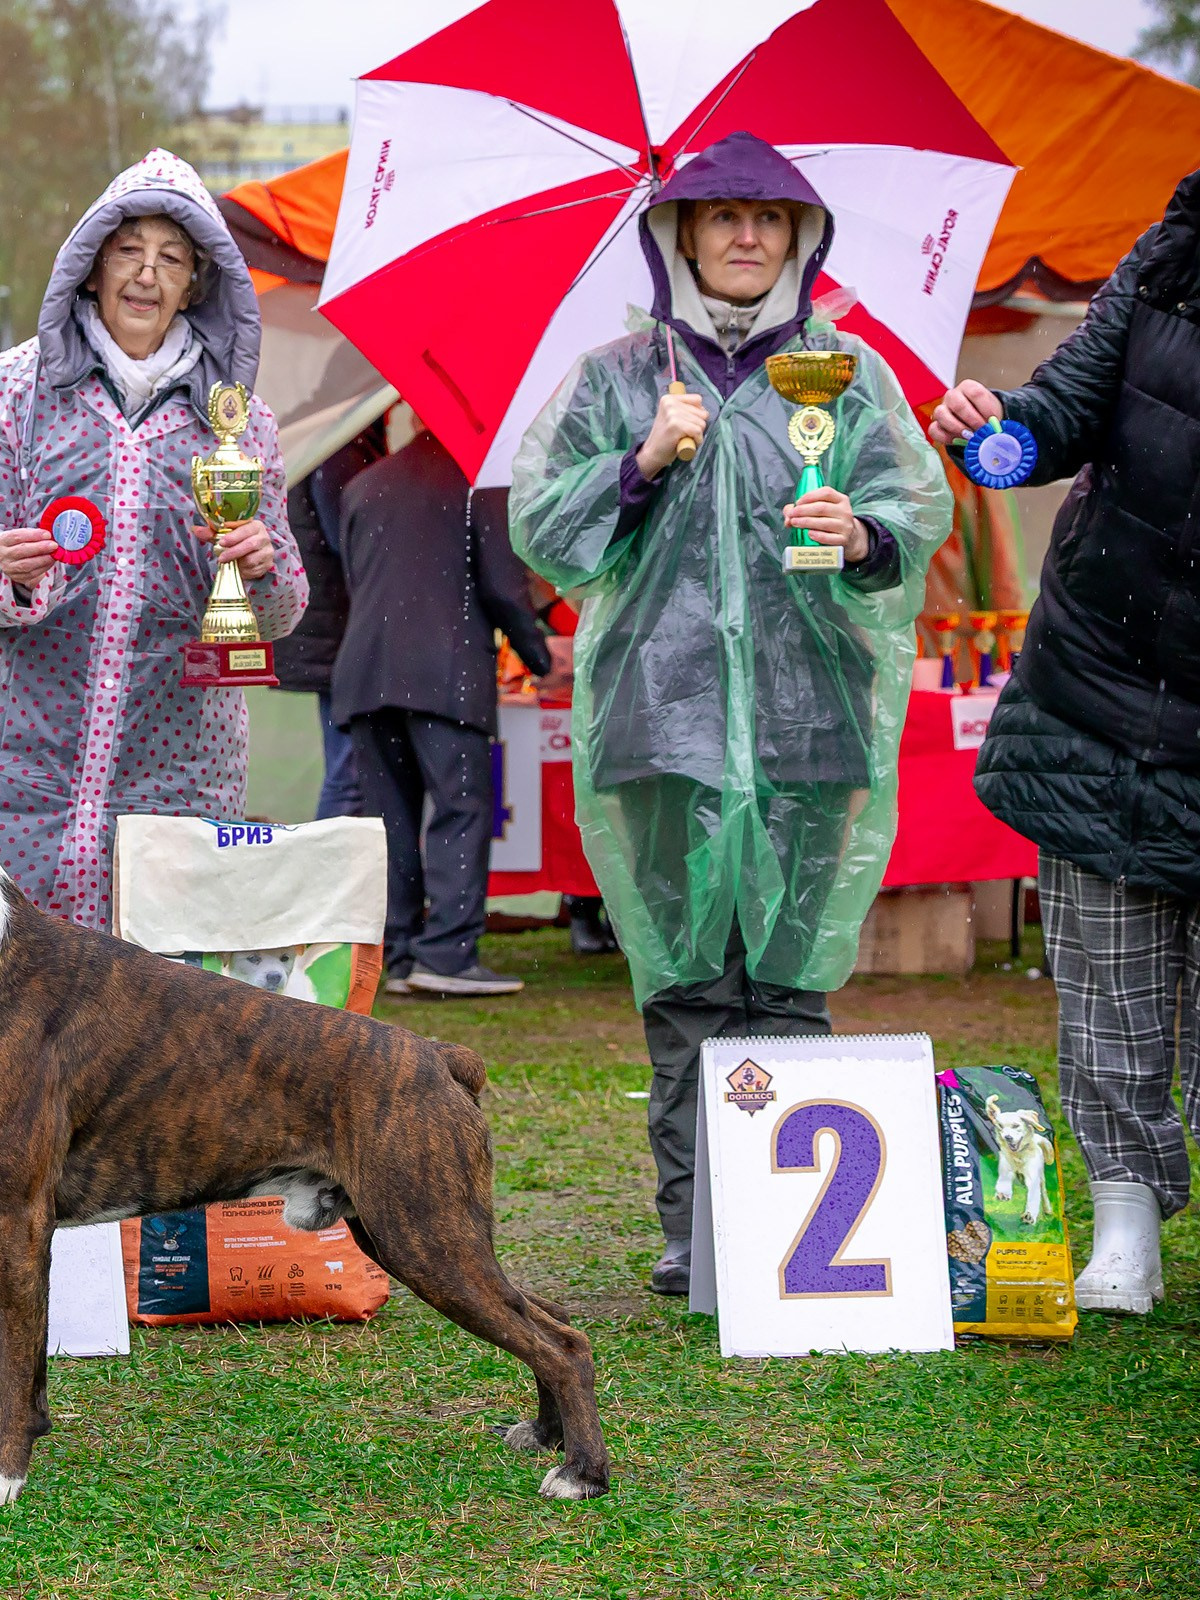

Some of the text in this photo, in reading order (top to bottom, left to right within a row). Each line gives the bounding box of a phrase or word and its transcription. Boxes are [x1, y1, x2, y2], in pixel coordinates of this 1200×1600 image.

[217, 826, 273, 848] БРИЗ
[947, 1094, 971, 1168] PUPPIES
[771, 1098, 893, 1299] 2
[955, 1169, 974, 1205] ALL
[996, 1248, 1027, 1256] PUPPIES
